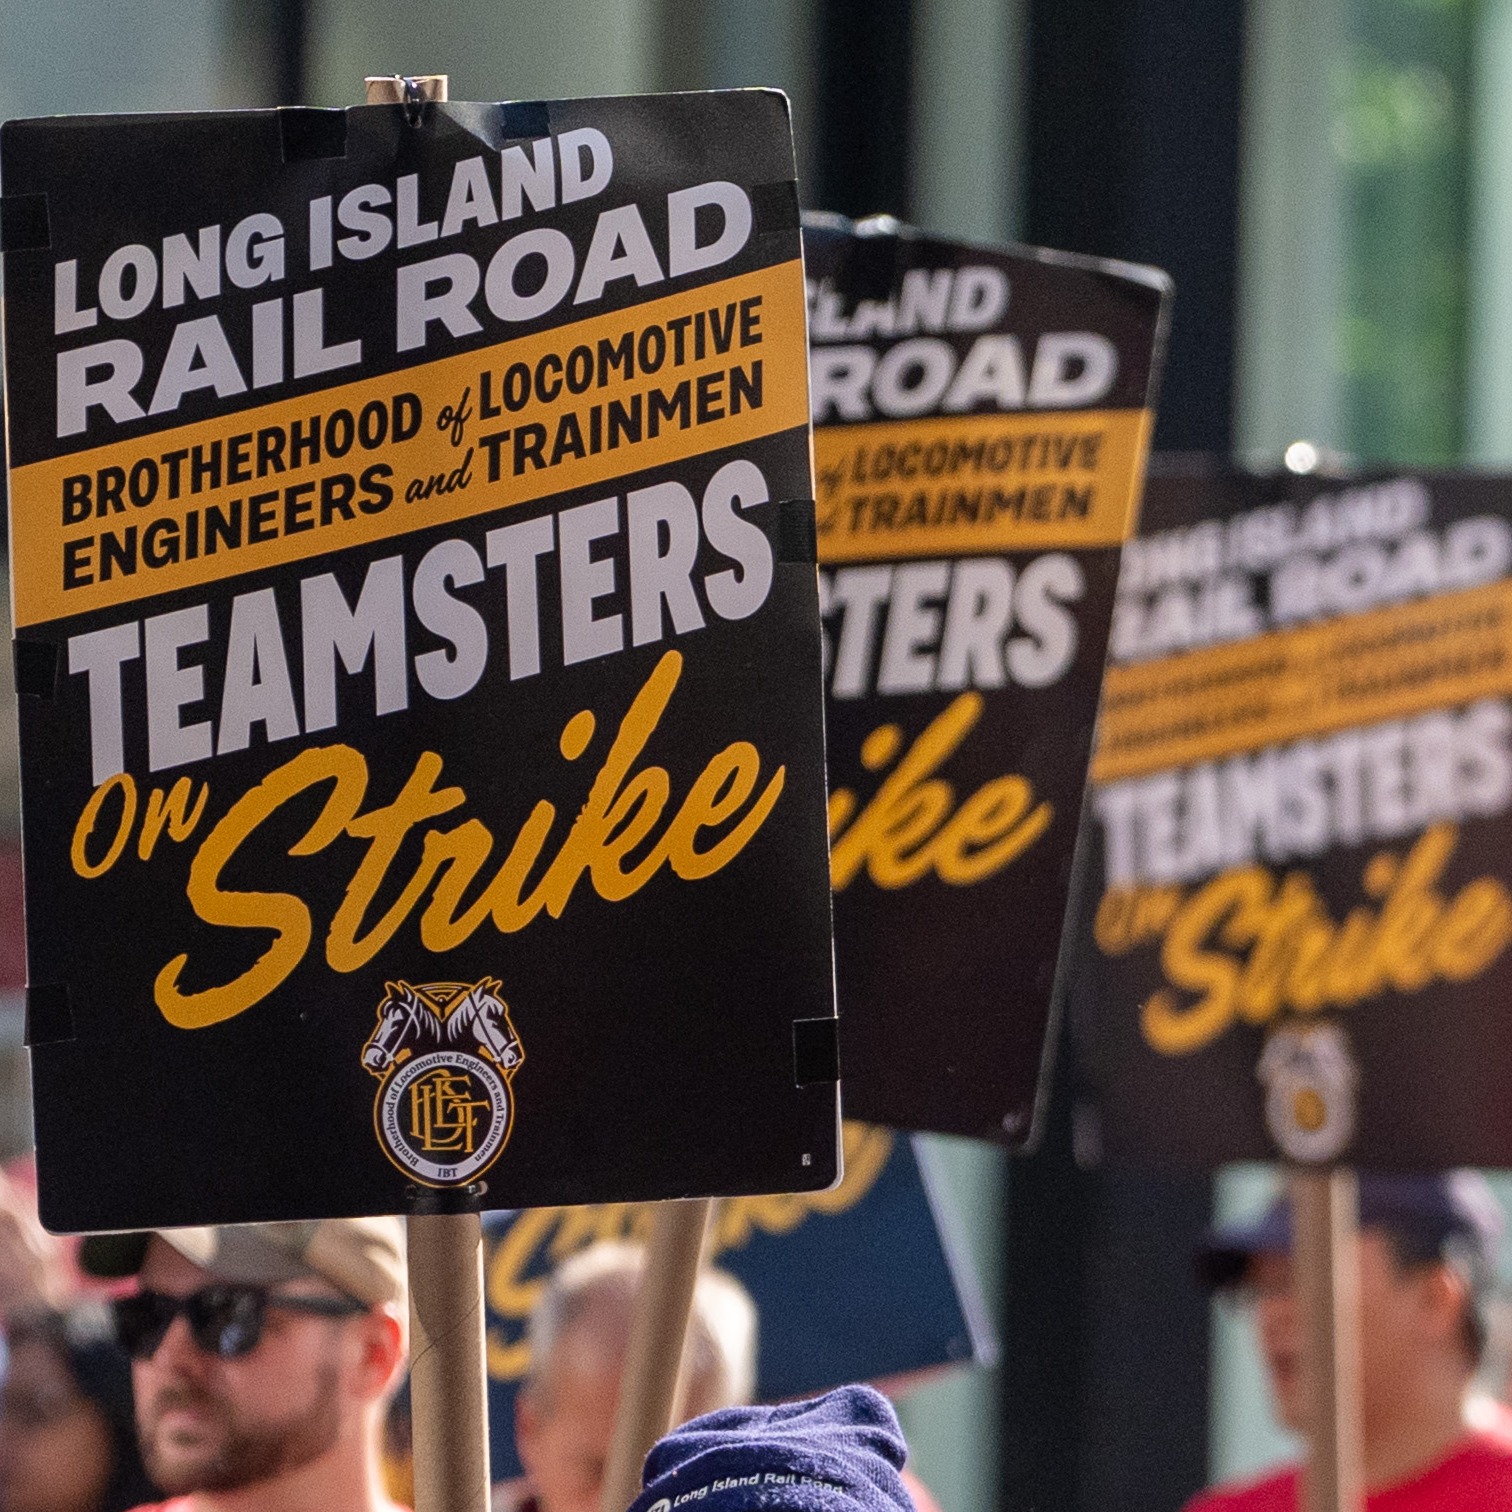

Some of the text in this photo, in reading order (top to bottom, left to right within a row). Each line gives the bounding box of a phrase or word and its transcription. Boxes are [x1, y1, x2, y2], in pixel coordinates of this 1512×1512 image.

[54, 127, 613, 334] LONG ISLAND
[56, 181, 752, 438] RAIL ROAD
[809, 331, 1119, 423] ROAD
[61, 296, 763, 525] BROTHERHOOD of LOCOMOTIVE
[62, 361, 762, 591] ENGINEERS and TRAINMEN
[852, 432, 1104, 484] LOCOMOTIVE
[849, 484, 1096, 535] TRAINMEN
[68, 459, 774, 785] TEAMSTERS
[71, 650, 785, 1029] On Strike
[394, 1054, 454, 1089] Locomotive
[455, 1054, 498, 1093] Engineers
[437, 1167, 458, 1178] IBT
[673, 1485, 709, 1508] Long
[712, 1473, 760, 1492] Island
[763, 1472, 796, 1485] Rail
